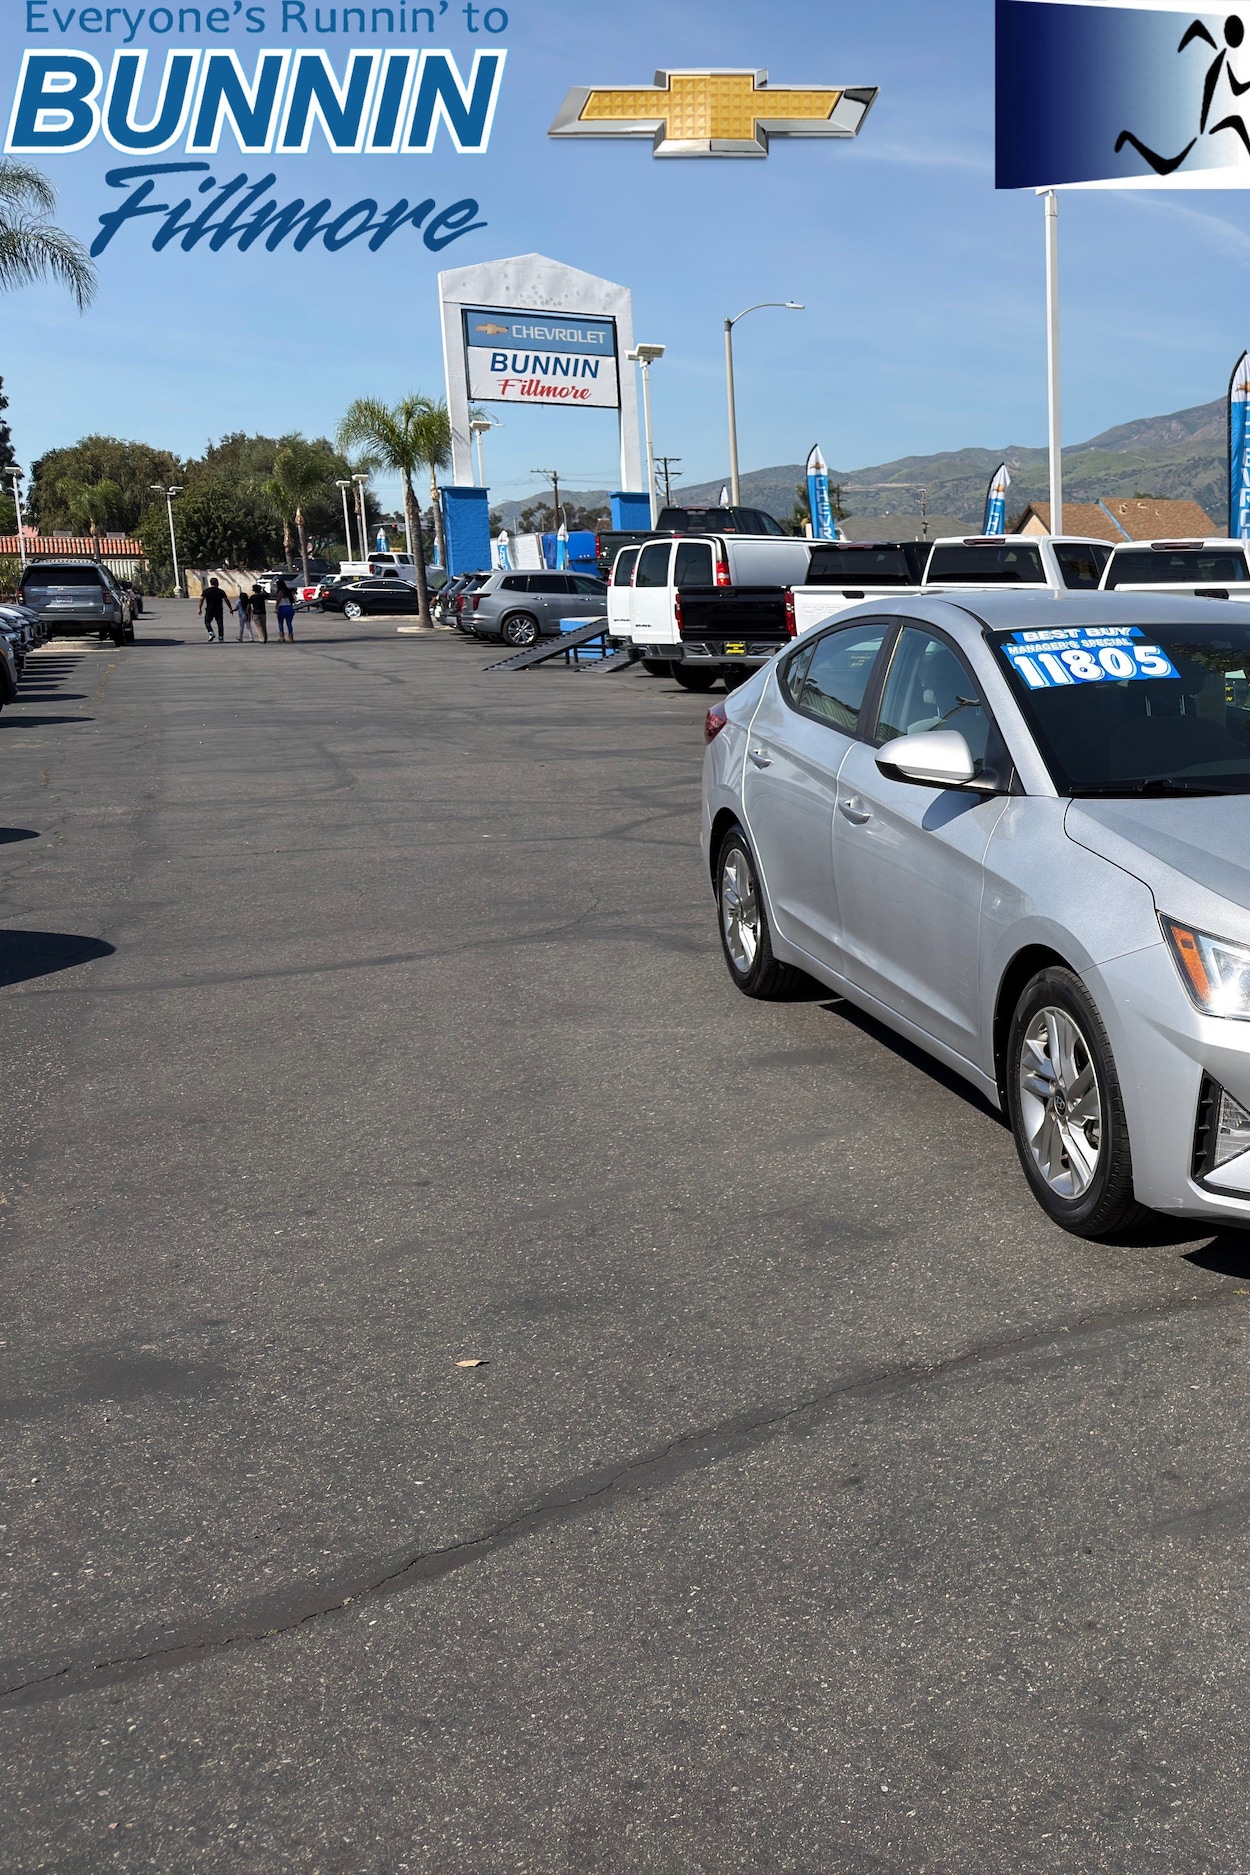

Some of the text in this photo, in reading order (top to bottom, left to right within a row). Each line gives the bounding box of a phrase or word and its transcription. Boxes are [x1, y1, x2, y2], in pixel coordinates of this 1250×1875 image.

[512, 324, 606, 344] CHEVROLET
[490, 352, 600, 379] BUNNIN
[496, 378, 592, 400] Fillmore
[1022, 626, 1132, 643] BEST BUY
[1007, 637, 1133, 655] MANAGER'S SPECIAL
[1014, 645, 1172, 687] 11805
